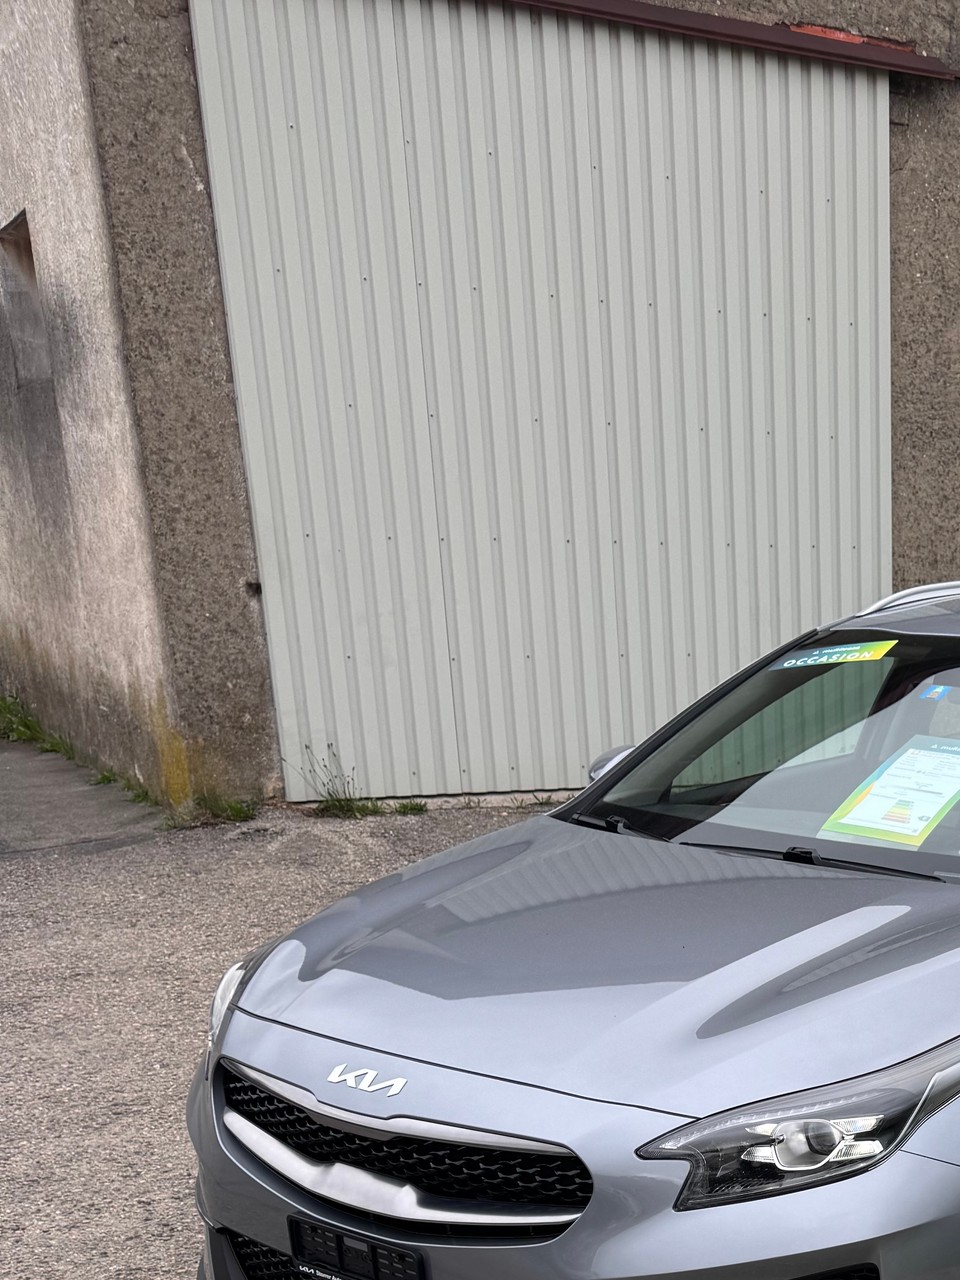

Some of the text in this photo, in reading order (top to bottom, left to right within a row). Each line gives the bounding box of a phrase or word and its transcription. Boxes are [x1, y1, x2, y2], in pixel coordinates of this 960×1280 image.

[783, 651, 874, 667] OCCASION
[327, 1063, 408, 1098] KIA
[299, 1265, 315, 1274] KIA
